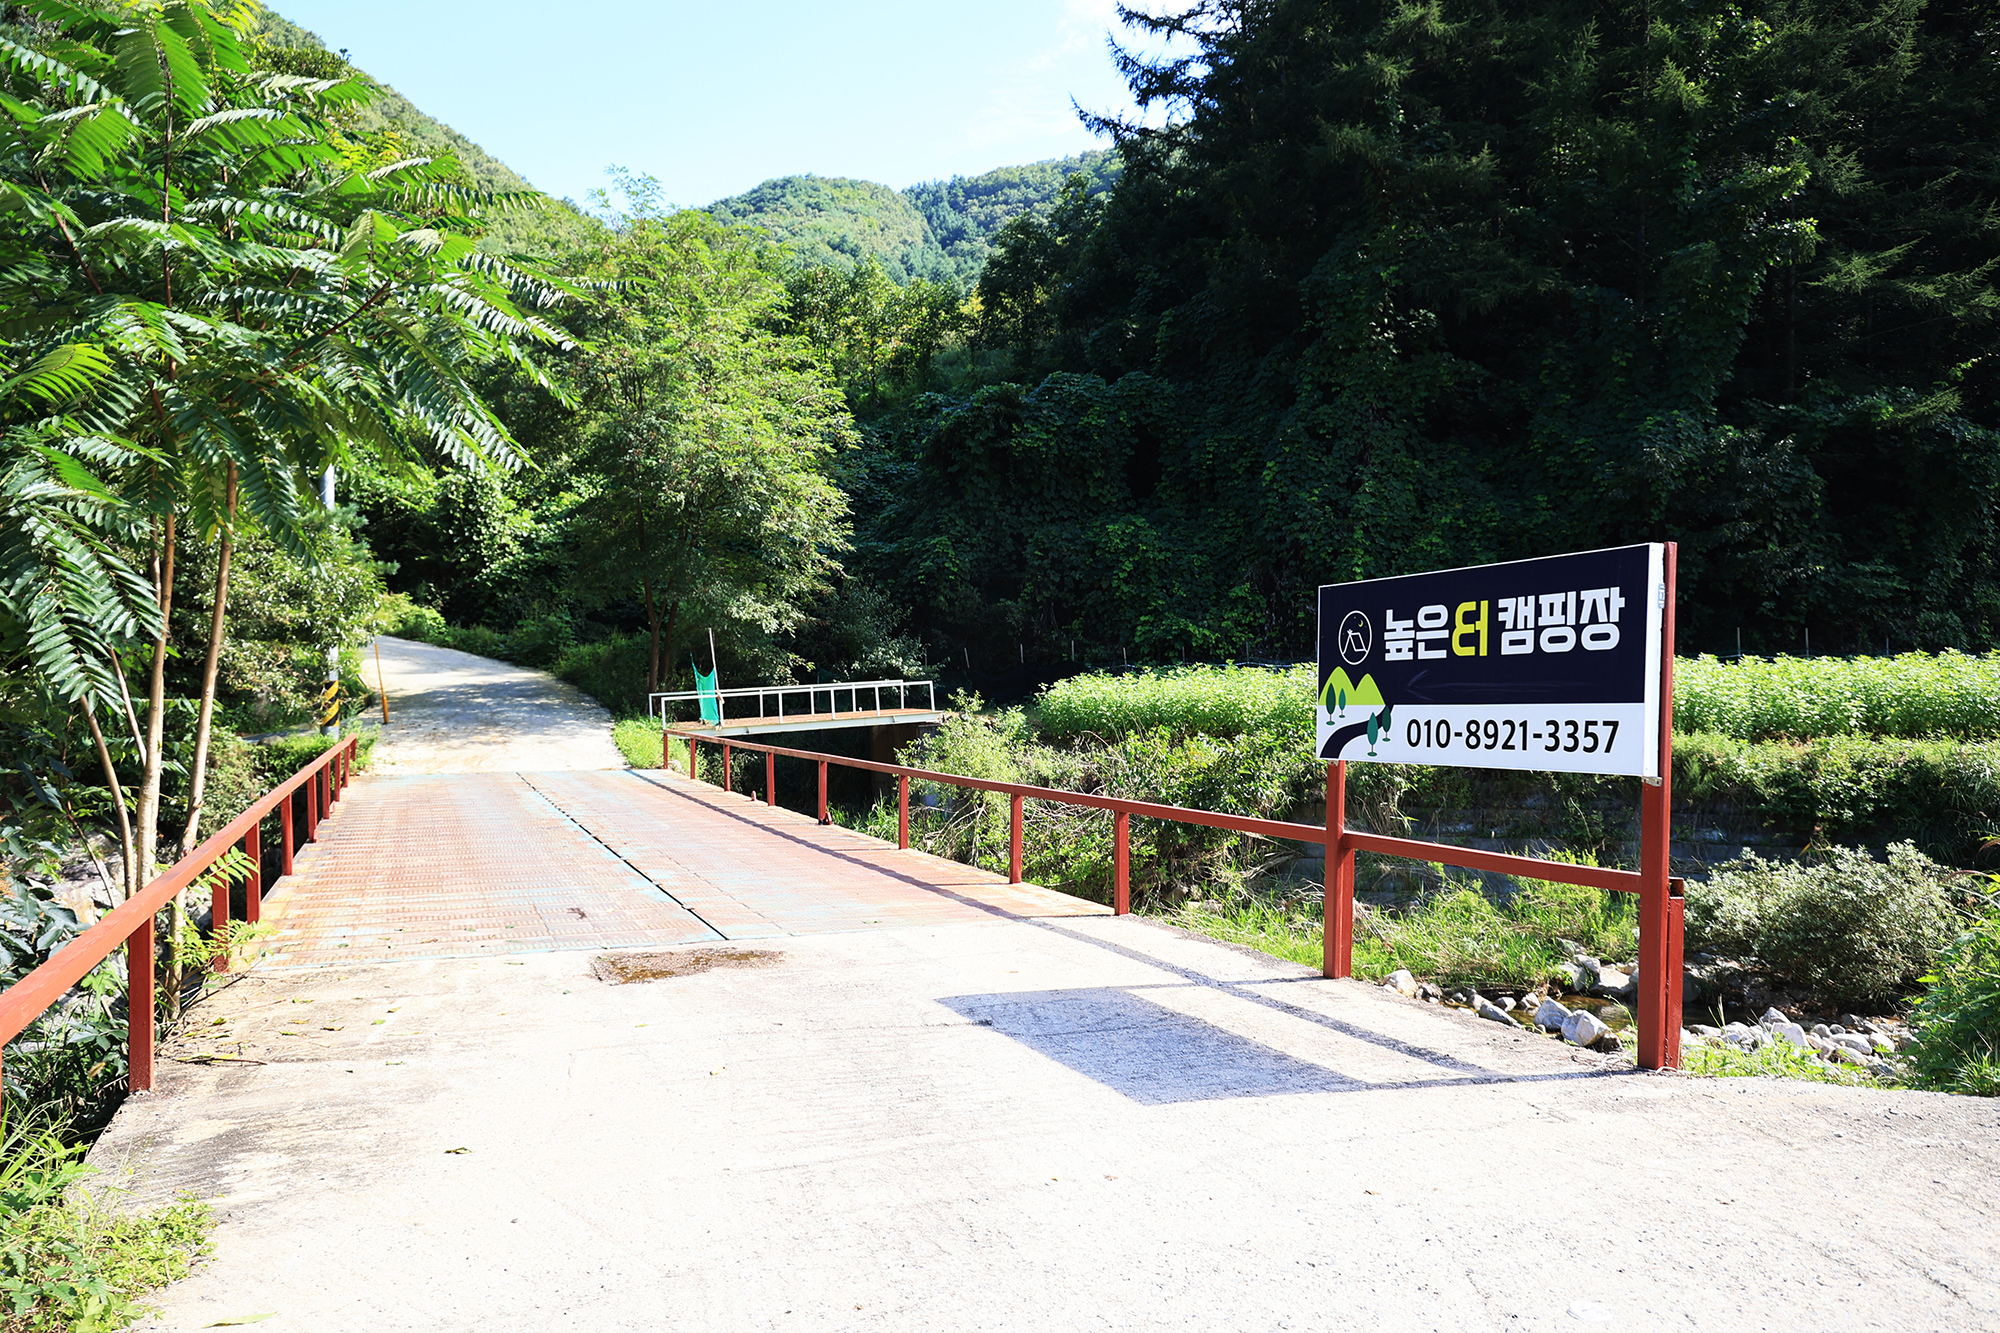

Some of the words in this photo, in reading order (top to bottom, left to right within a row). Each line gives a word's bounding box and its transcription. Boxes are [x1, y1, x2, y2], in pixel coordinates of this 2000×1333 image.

[1383, 599, 1489, 662] 높은터
[1497, 586, 1626, 656] 캠핑장
[1406, 717, 1620, 754] 010-8921-3357
